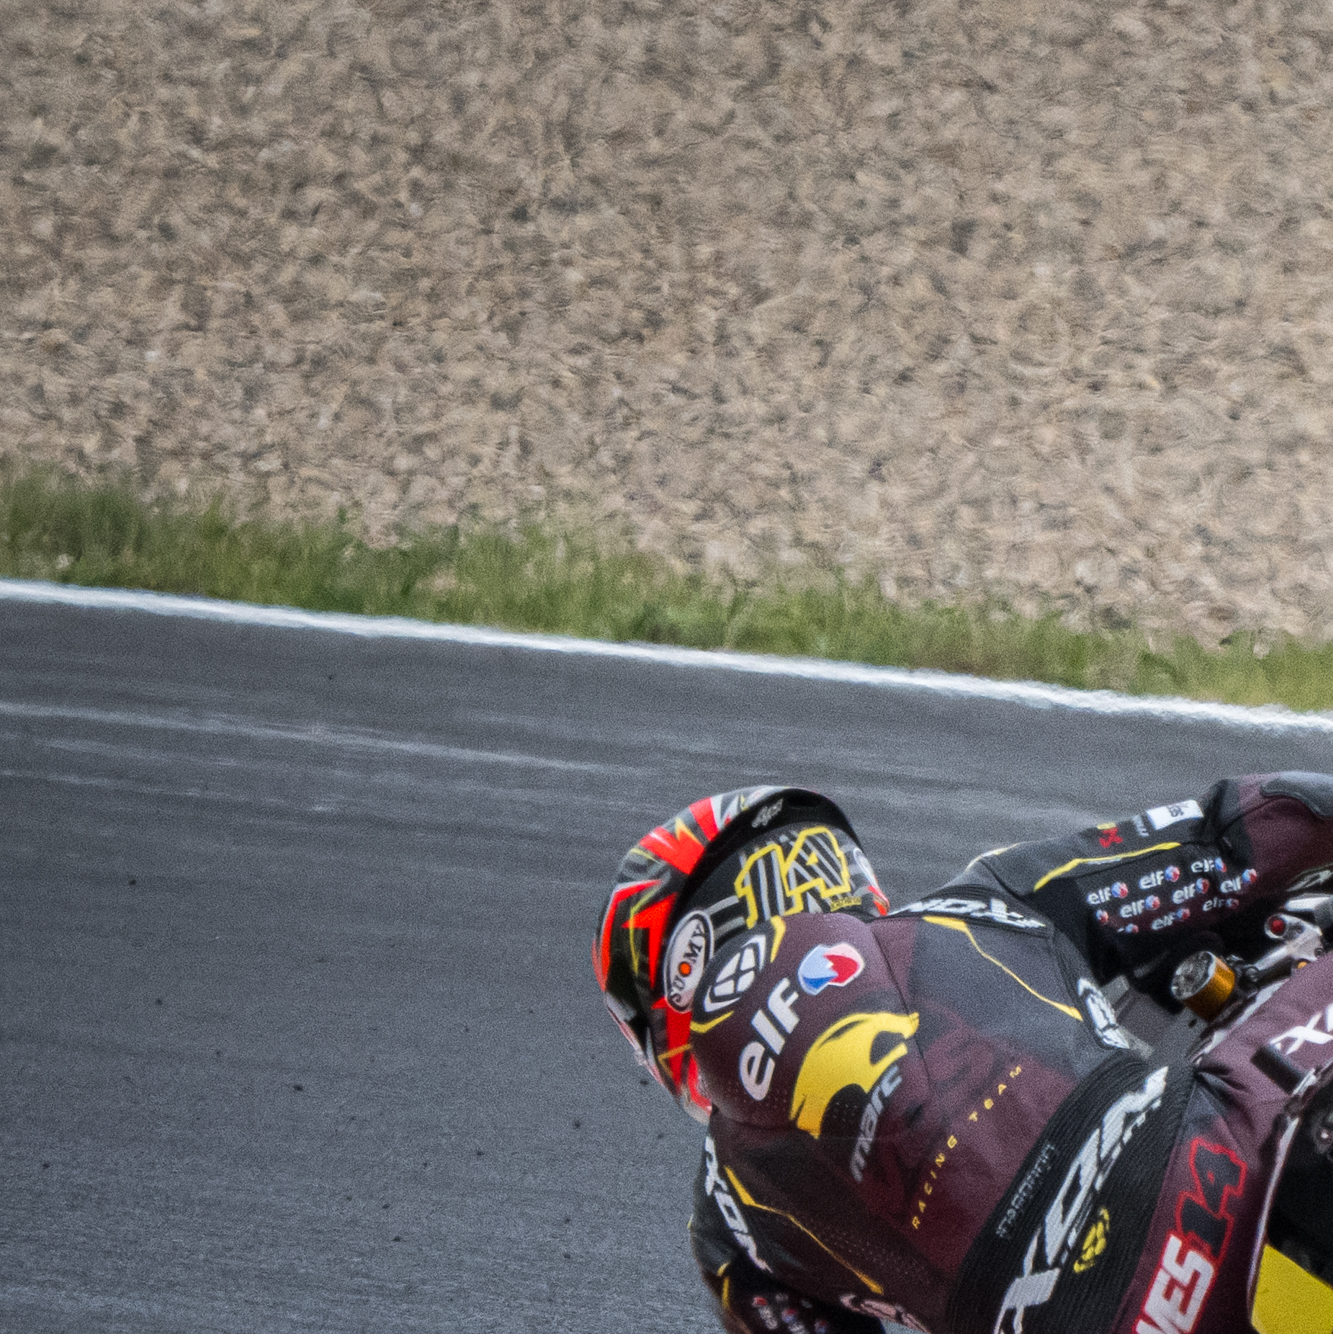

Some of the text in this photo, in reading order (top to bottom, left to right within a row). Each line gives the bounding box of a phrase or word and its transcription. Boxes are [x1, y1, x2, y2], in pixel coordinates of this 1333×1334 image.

[1191, 859, 1215, 874] elf
[1139, 871, 1164, 890] elf
[1220, 877, 1241, 893] elf
[1087, 888, 1112, 905] elf
[1172, 884, 1195, 904] elf
[1120, 900, 1145, 918] elf
[1152, 912, 1176, 930] elf
[739, 977, 800, 1101] elf
[850, 1064, 902, 1183] marc
[912, 1066, 1022, 1230] RACING TEAM
